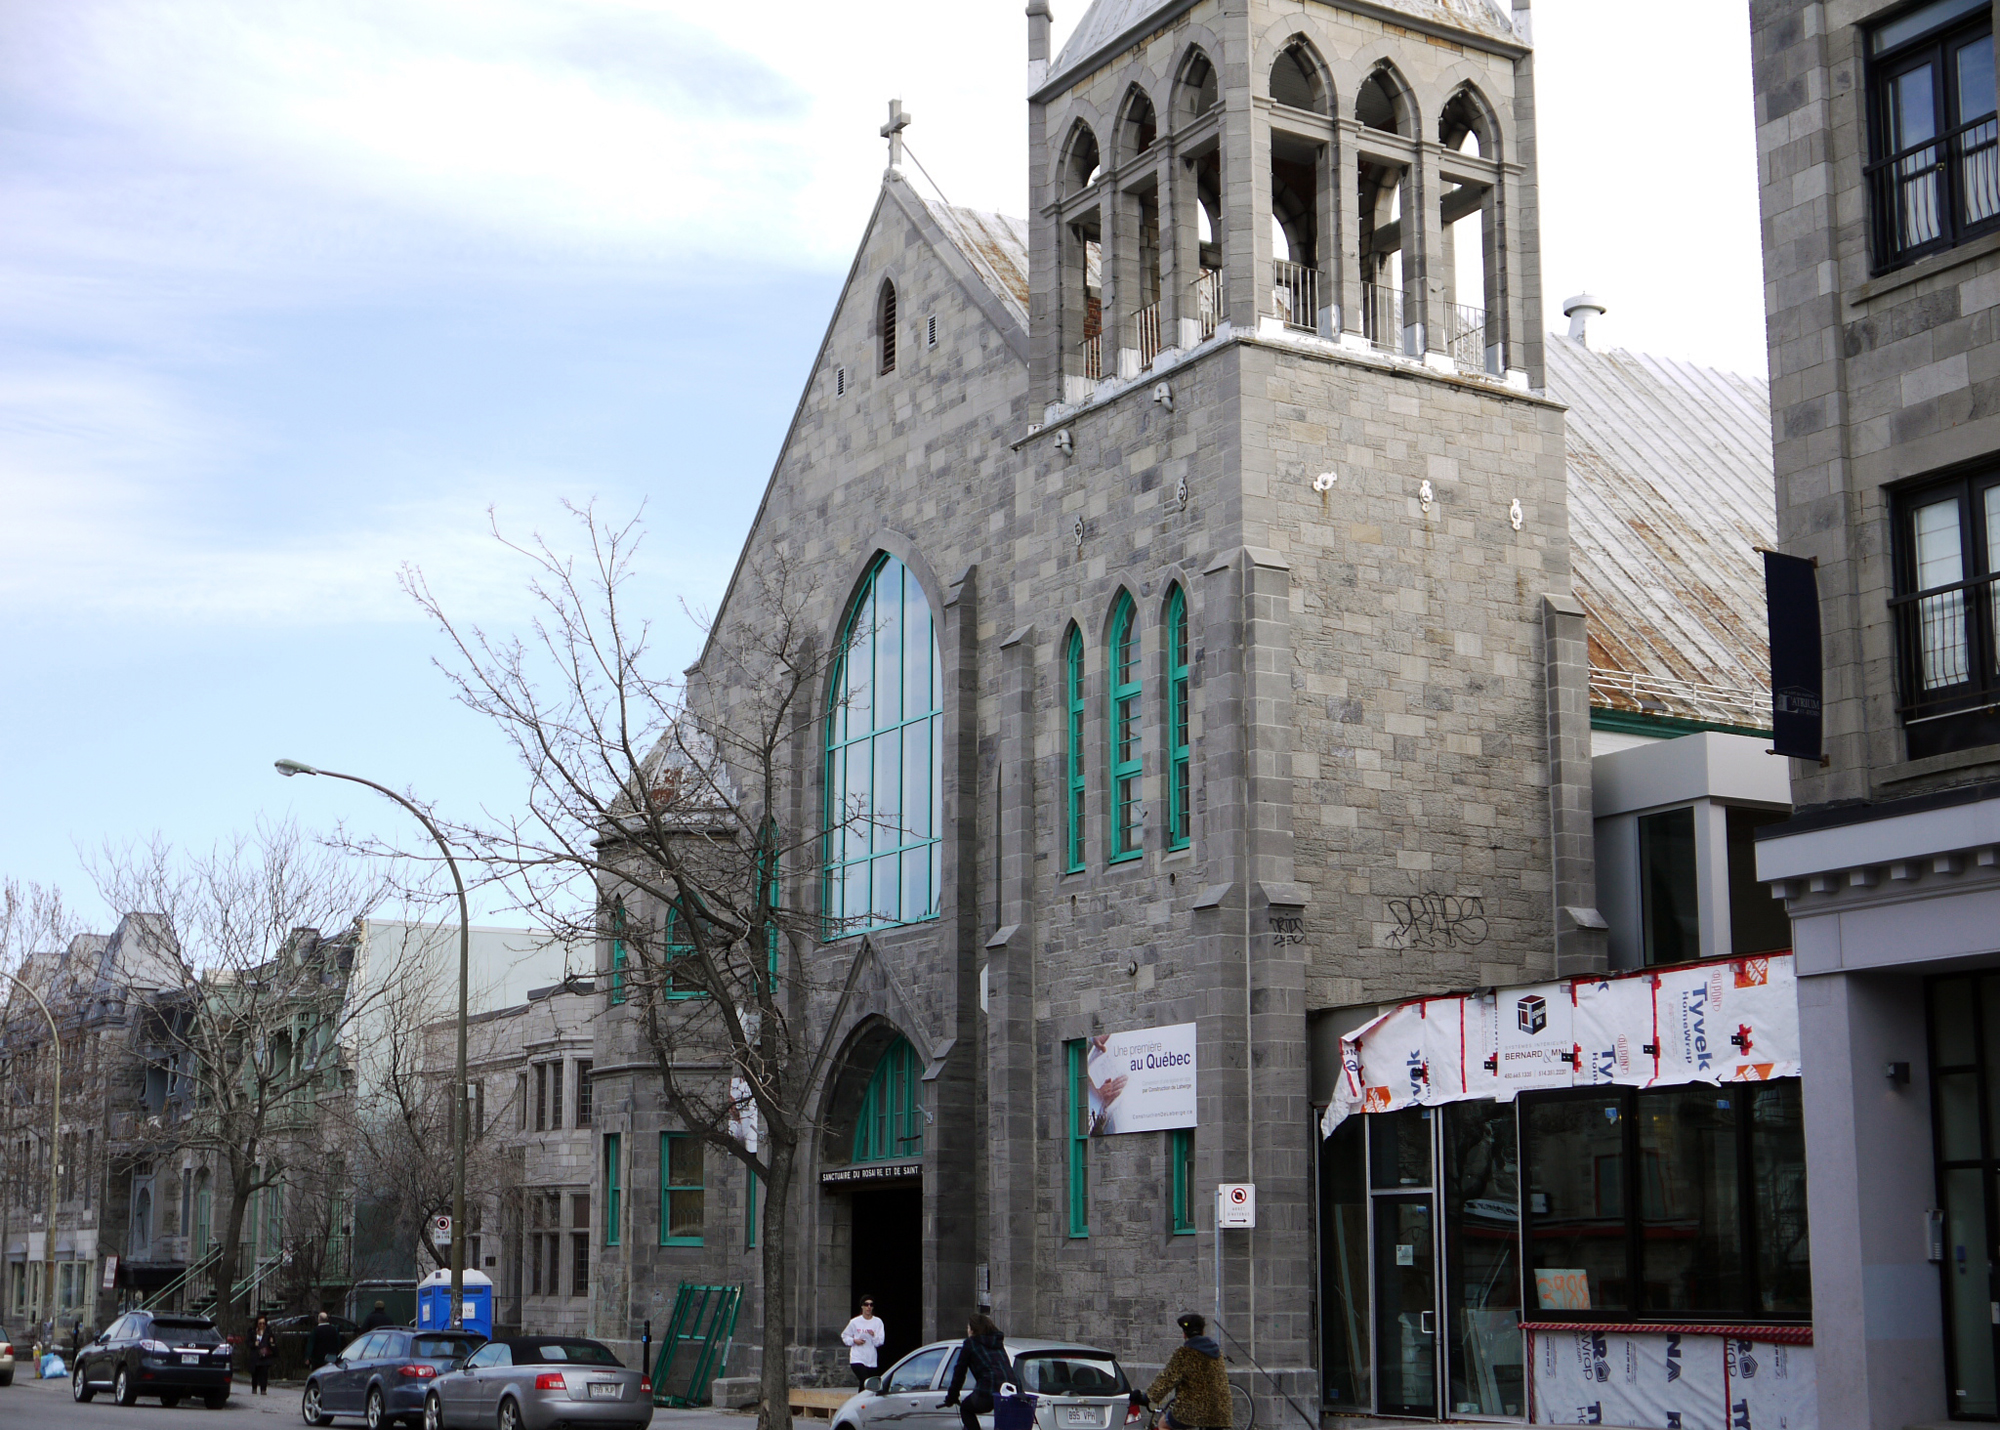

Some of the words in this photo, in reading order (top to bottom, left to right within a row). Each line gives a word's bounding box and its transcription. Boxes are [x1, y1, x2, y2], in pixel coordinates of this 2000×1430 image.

[1682, 991, 1692, 1064] HomeWrap
[1688, 981, 1713, 1072] Tyvek
[1113, 1045, 1128, 1057] Une
[1129, 1041, 1162, 1057] première
[1505, 1050, 1543, 1061] BERNARD
[1543, 1048, 1552, 1064] &
[1130, 1059, 1143, 1071] au
[1146, 1051, 1191, 1070] Québec
[1599, 1044, 1617, 1084] Ty
[1148, 1085, 1171, 1093] Construction
[822, 1171, 851, 1182] SANCTUAIRE
[852, 1170, 860, 1179] DU
[885, 1167, 892, 1176] ET
[893, 1167, 901, 1176] DE
[903, 1166, 918, 1175] SAINT
